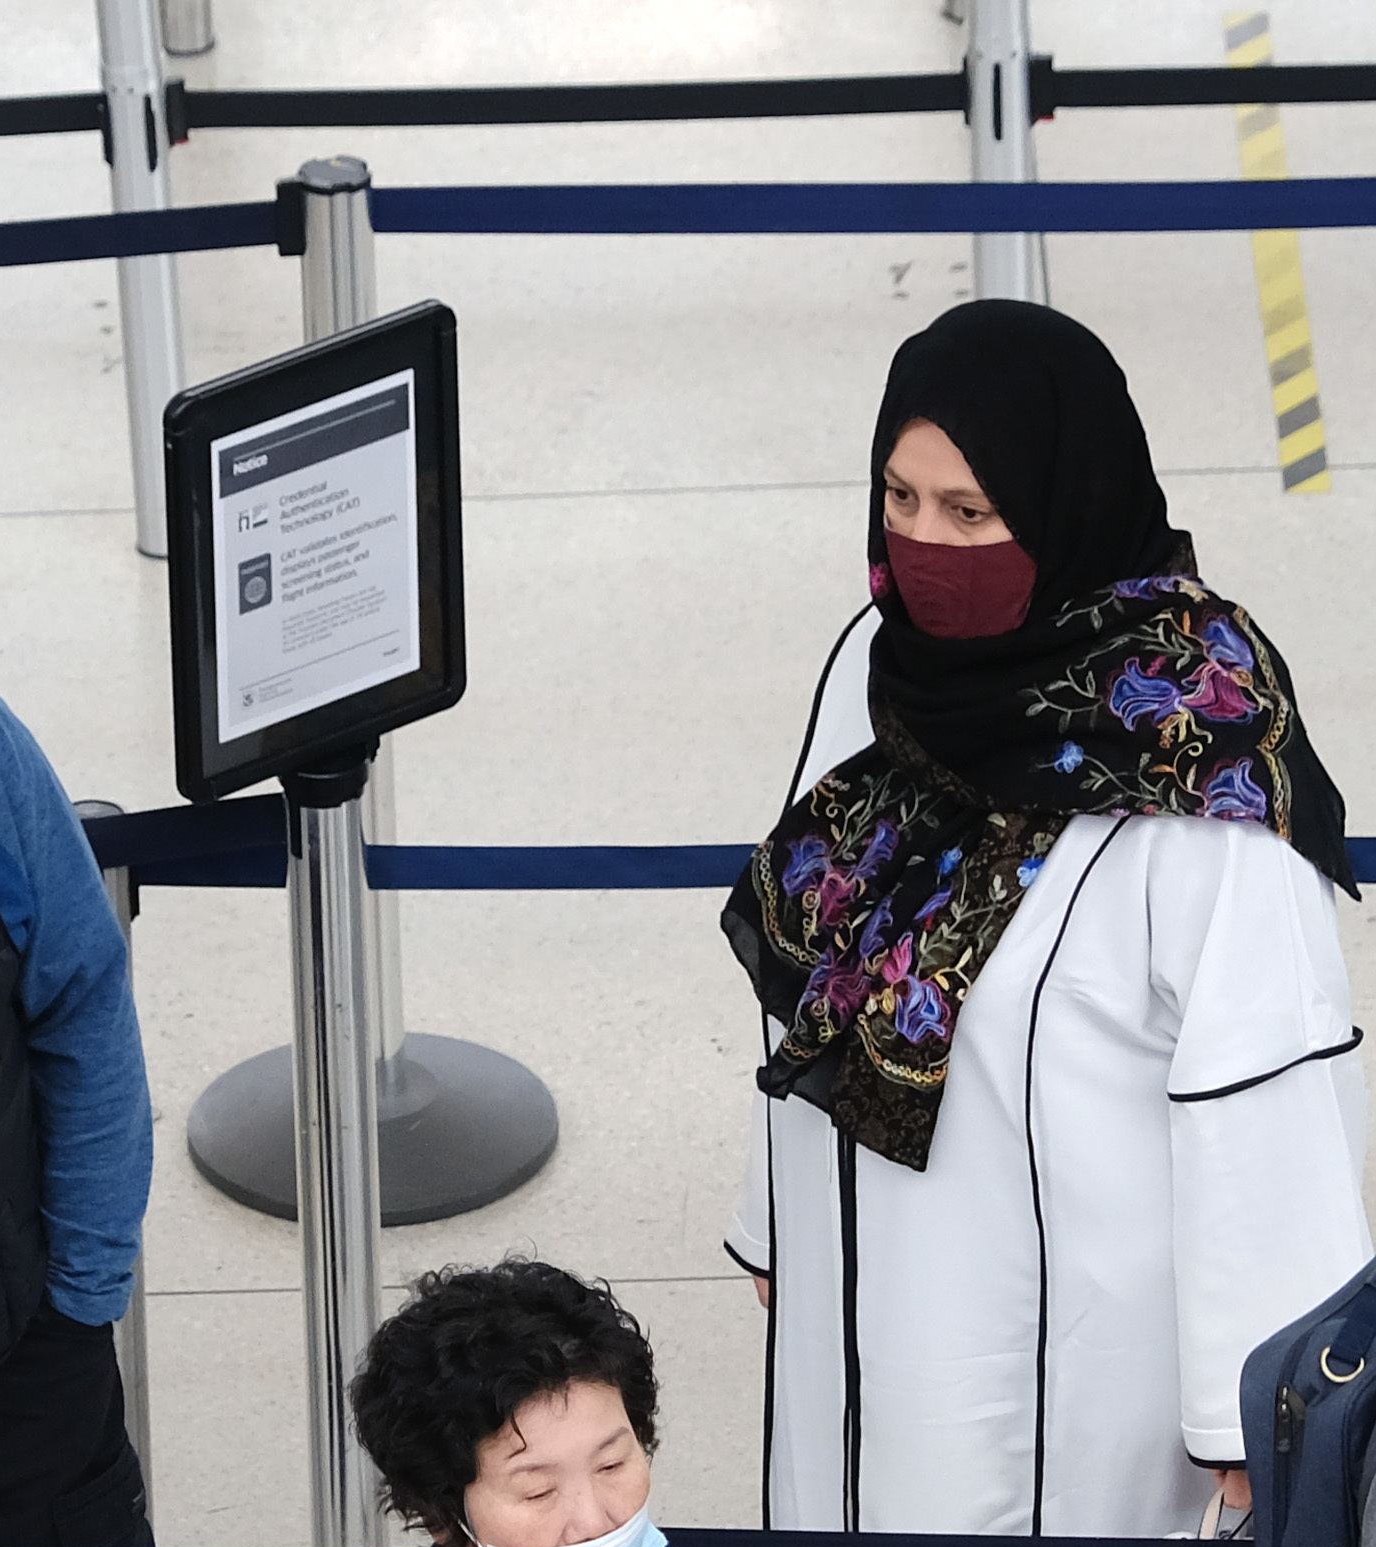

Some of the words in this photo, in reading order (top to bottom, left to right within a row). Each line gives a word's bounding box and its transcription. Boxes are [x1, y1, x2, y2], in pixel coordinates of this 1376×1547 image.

[232, 454, 268, 477] Notice
[279, 480, 328, 507] Credential
[280, 488, 349, 520] Authentication
[280, 509, 333, 534] Technology
[335, 496, 361, 516] (CAT)
[280, 549, 297, 564] CAT
[317, 540, 361, 569] passenger
[353, 549, 370, 563] and
